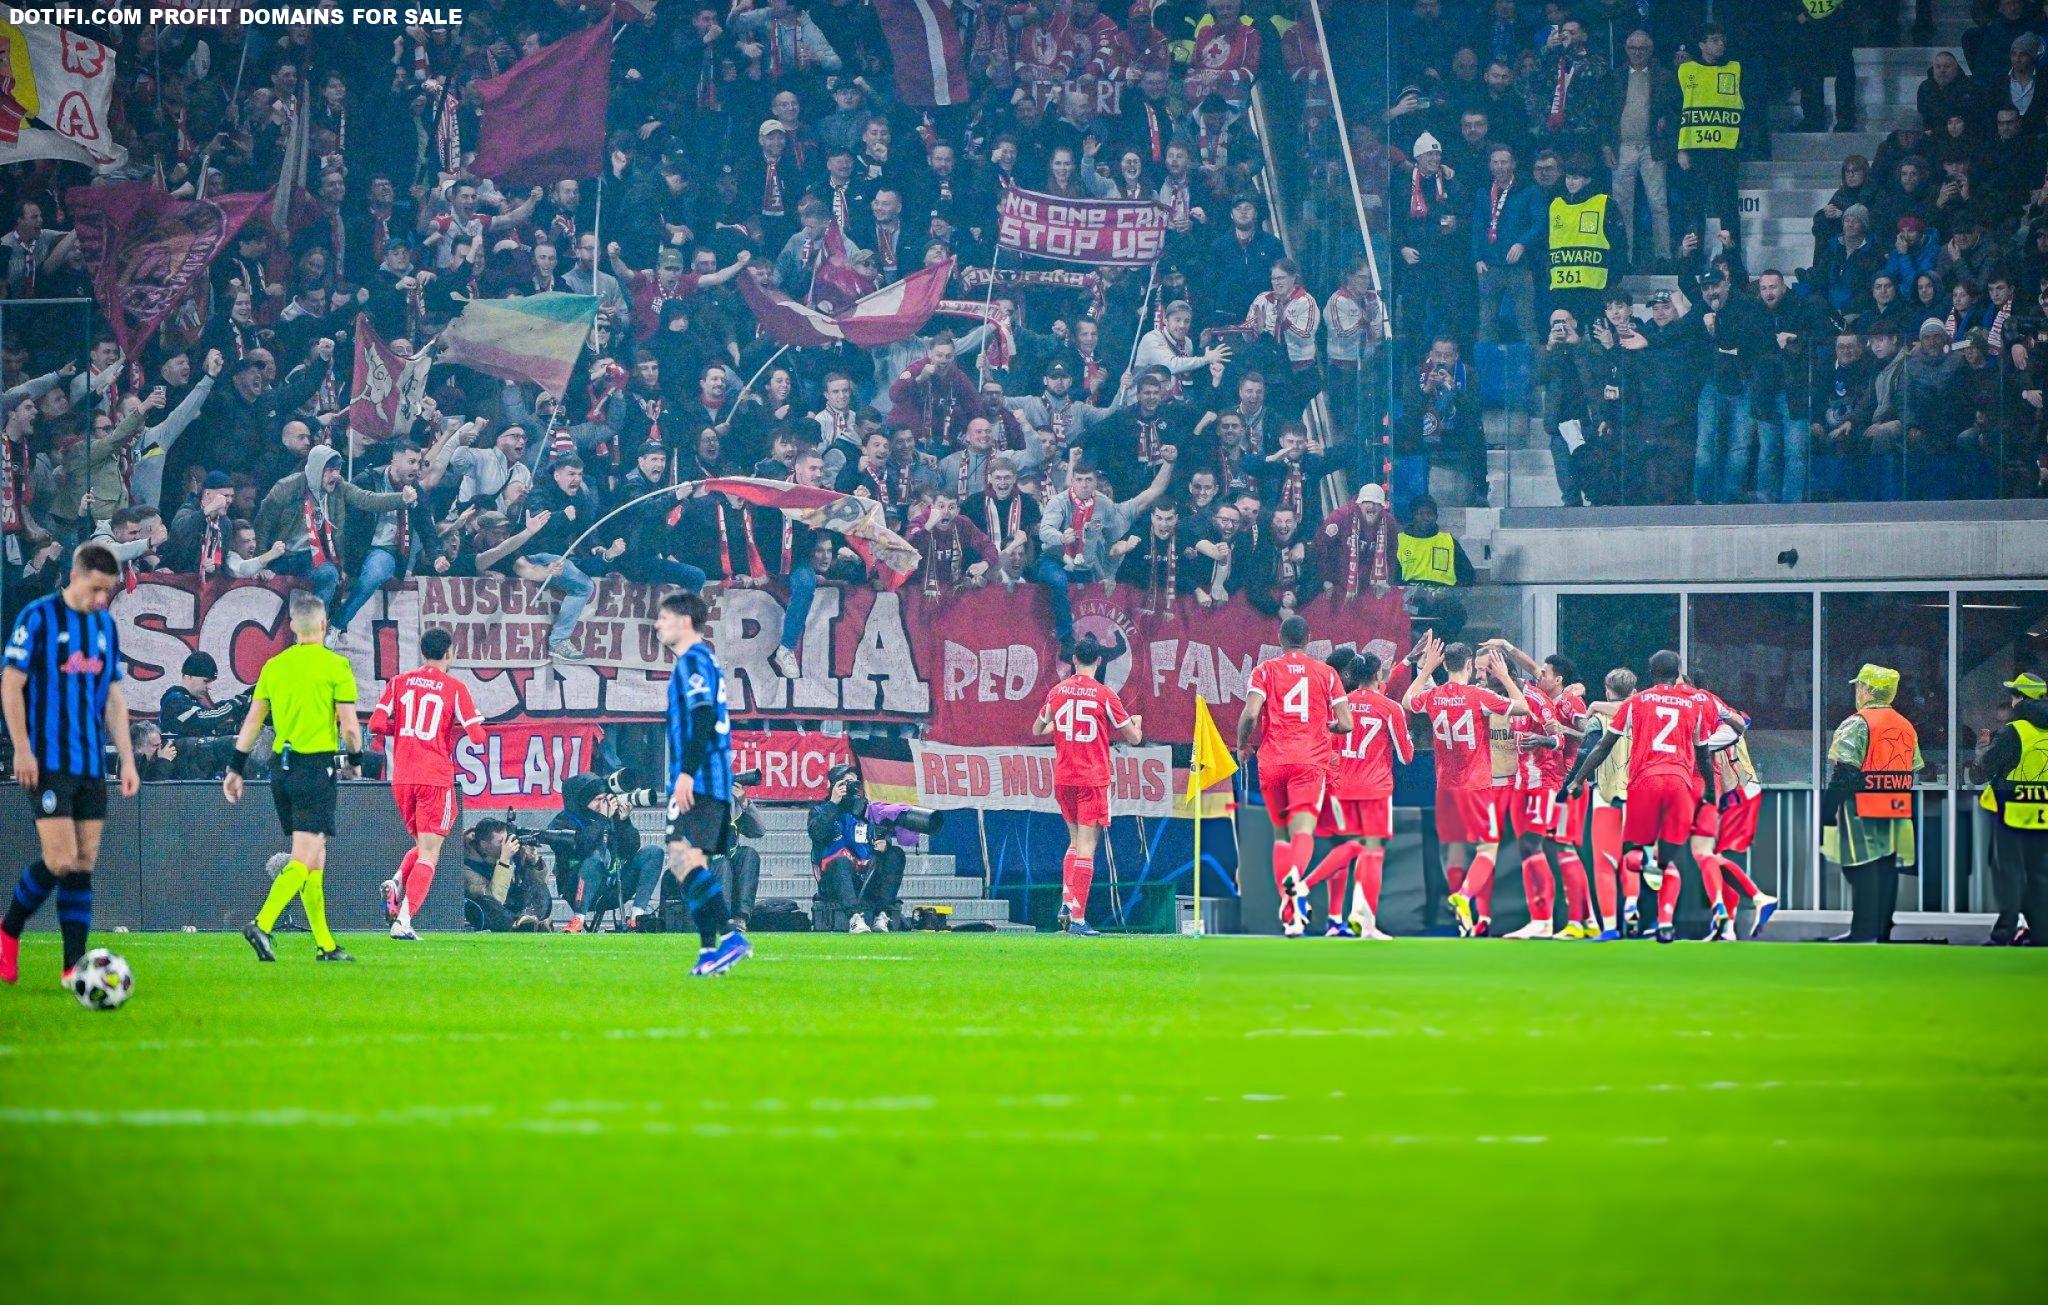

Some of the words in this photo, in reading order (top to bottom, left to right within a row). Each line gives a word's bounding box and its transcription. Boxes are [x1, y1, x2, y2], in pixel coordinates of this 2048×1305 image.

[1810, 0, 1834, 14] 213
[1696, 129, 1722, 144] 340
[1005, 192, 1038, 221] NO
[1047, 204, 1107, 229] ONE
[1000, 215, 1099, 256] STOP
[1549, 249, 1603, 265] TEWARD
[1556, 270, 1582, 284] 361
[943, 639, 1040, 704] RED
[1287, 664, 1306, 675] TAH
[400, 689, 445, 742] 10
[1282, 676, 1310, 723] 4
[1054, 698, 1099, 743] 45
[1341, 716, 1383, 760] 17
[1432, 709, 1477, 750] 44
[1652, 705, 1680, 754] 2
[921, 752, 992, 797] RED
